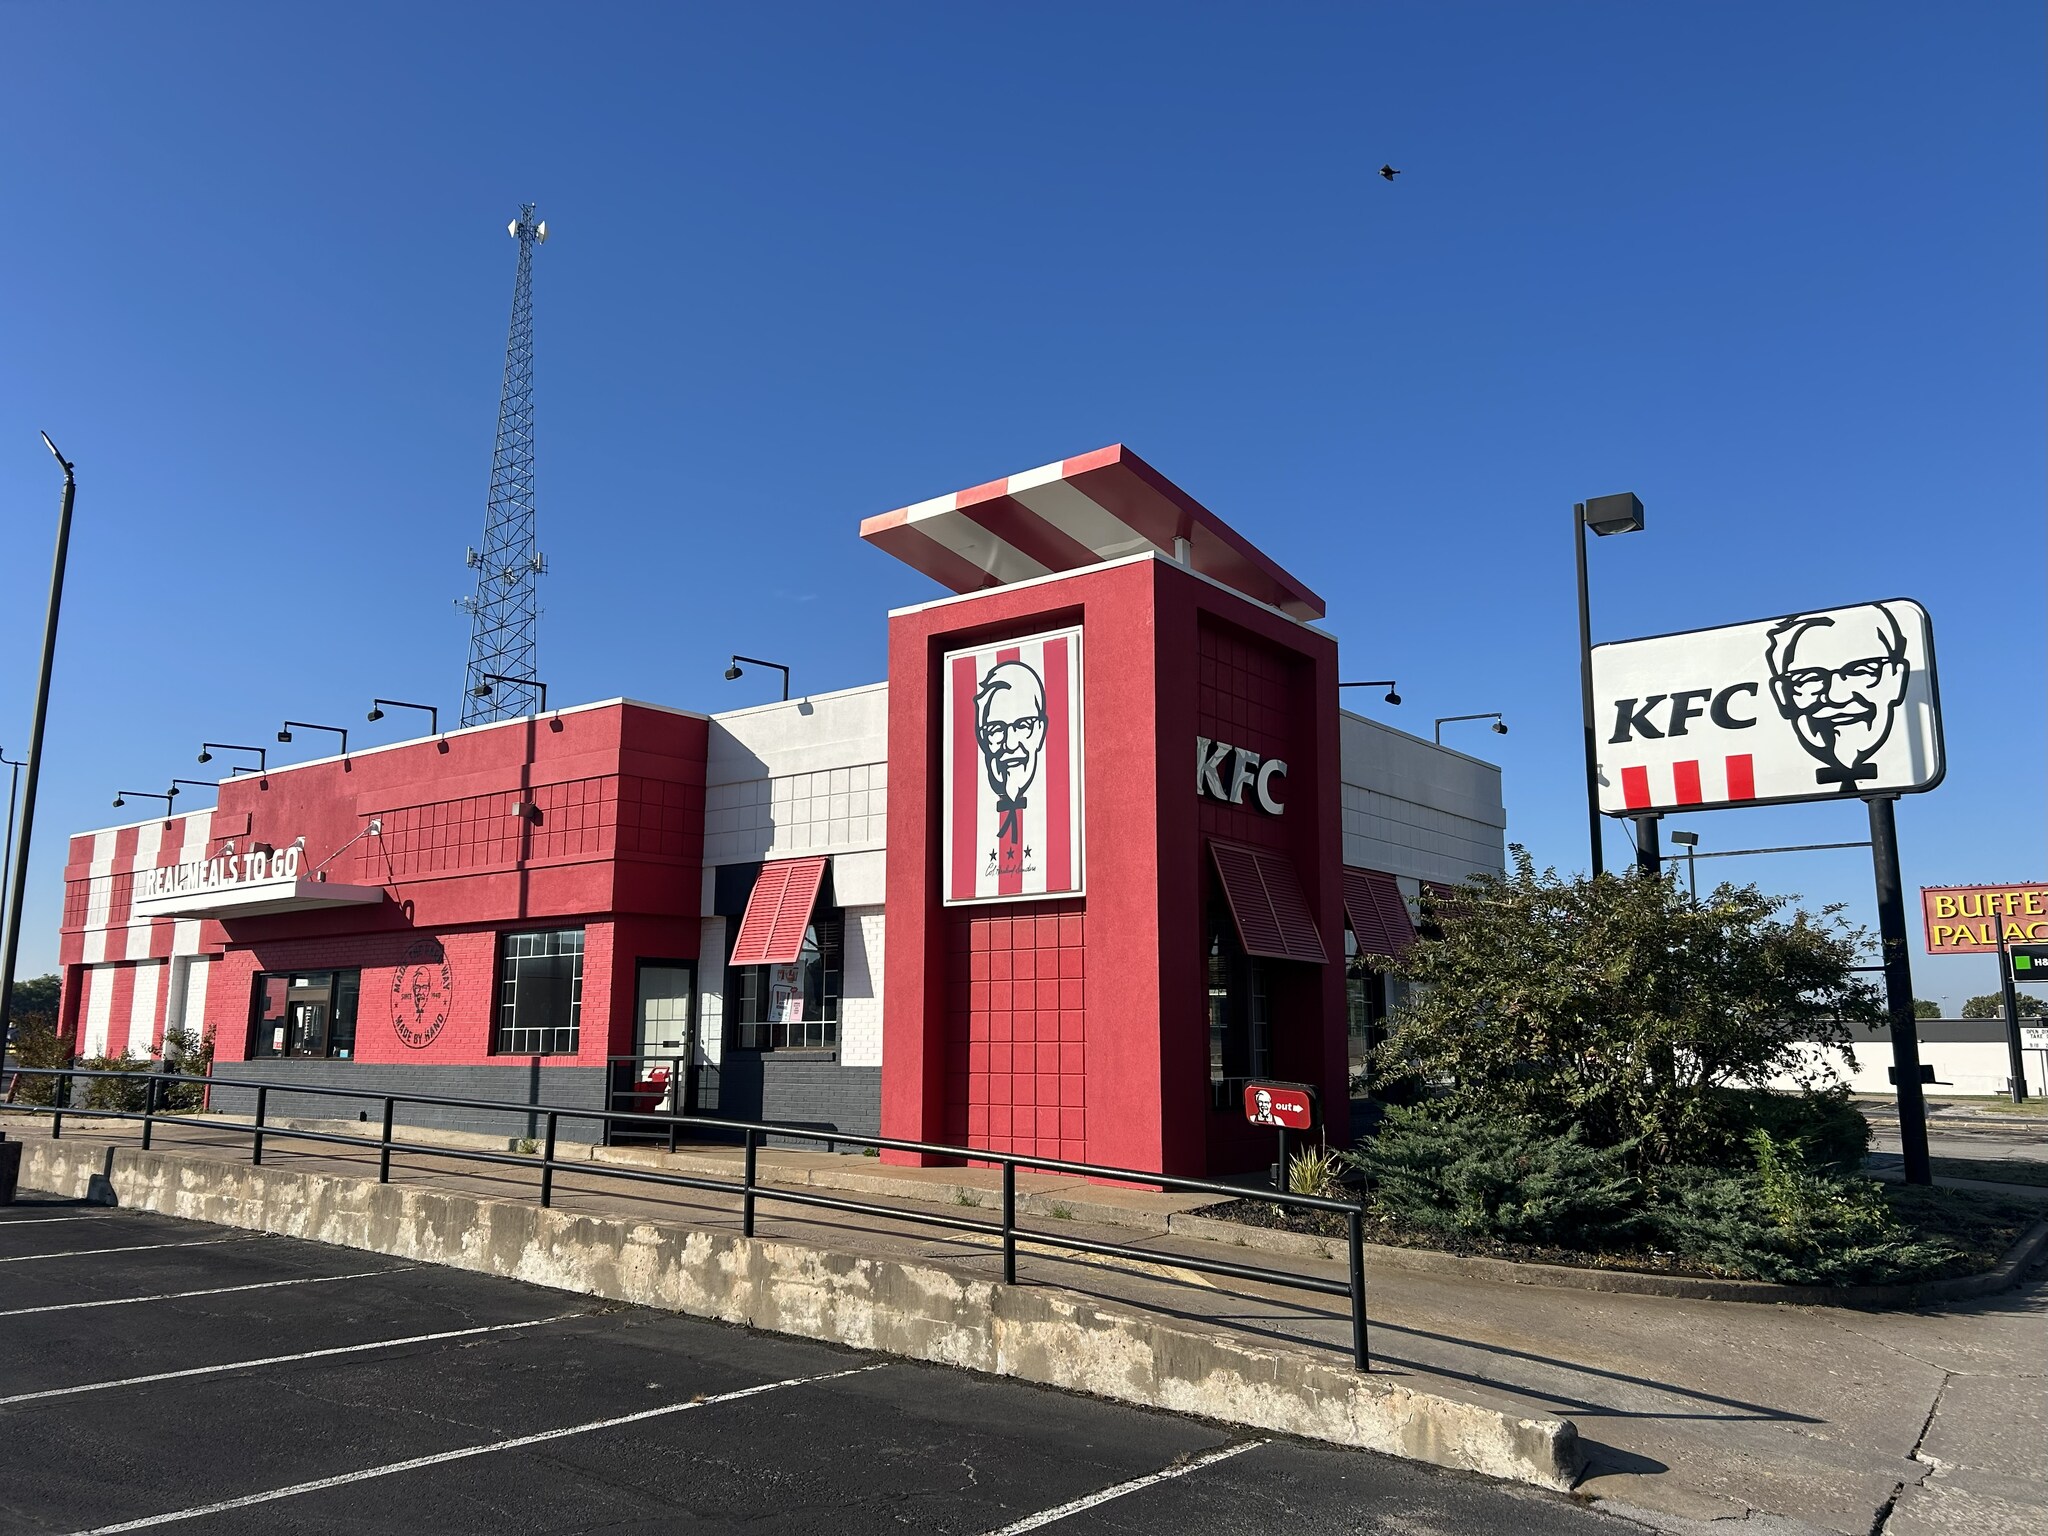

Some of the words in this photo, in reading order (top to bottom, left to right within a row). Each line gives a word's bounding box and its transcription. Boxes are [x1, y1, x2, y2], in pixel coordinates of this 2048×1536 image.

[1608, 682, 1759, 744] KFC
[1196, 735, 1288, 815] KFC
[147, 865, 183, 895] REAL
[187, 855, 239, 889] MEALS
[244, 851, 267, 882] TO
[271, 847, 299, 879] GO
[1935, 891, 2048, 918] BUFFE
[395, 1014, 413, 1043] MADE
[413, 1033, 423, 1044] BY
[425, 1013, 444, 1042] HAND
[1275, 1102, 1292, 1111] out
